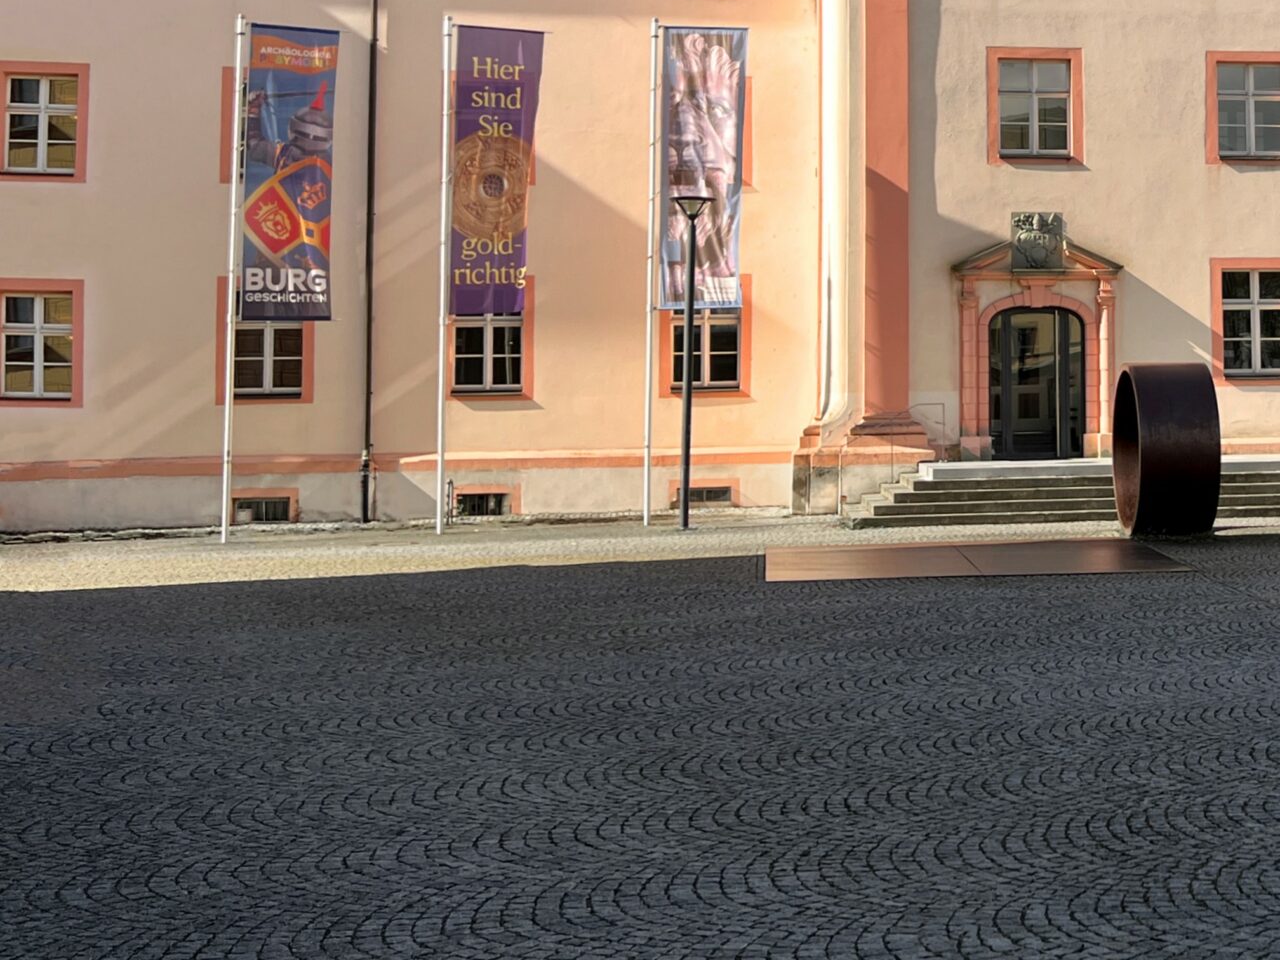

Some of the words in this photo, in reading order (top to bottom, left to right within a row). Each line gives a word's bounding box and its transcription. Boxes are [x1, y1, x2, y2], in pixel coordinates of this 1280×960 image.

[472, 56, 525, 81] Hier
[471, 86, 521, 109] sind
[478, 114, 513, 138] Sie
[461, 231, 522, 261] gold-
[245, 267, 327, 292] BURG
[453, 261, 527, 289] richtig
